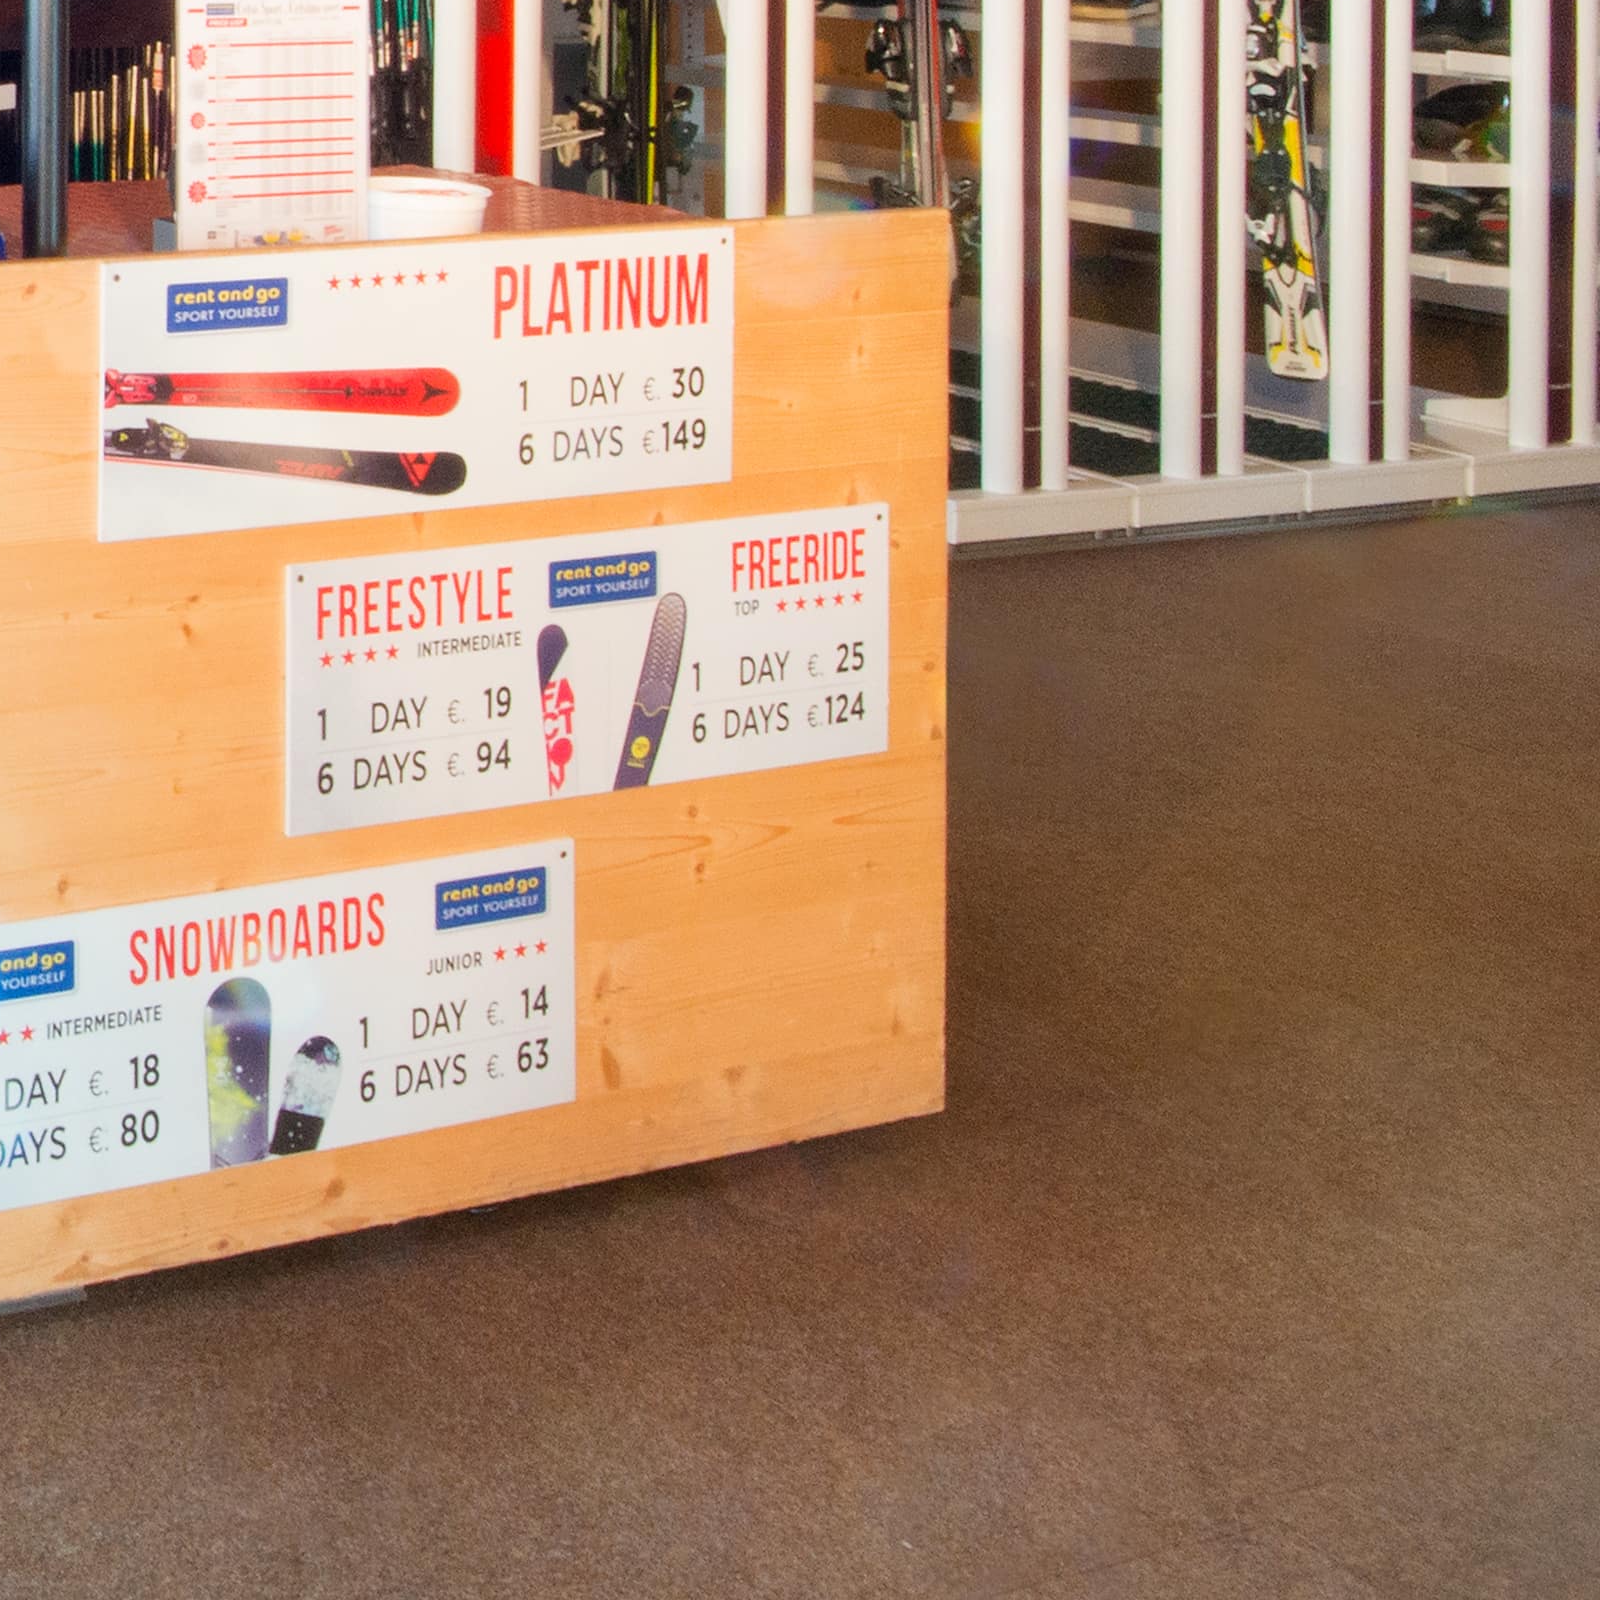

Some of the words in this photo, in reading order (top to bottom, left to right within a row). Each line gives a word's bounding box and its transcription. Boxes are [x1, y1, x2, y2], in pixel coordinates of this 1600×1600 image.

[174, 289, 216, 305] rent
[217, 284, 255, 303] and
[254, 287, 282, 305] go
[174, 309, 215, 324] SPORT
[217, 305, 280, 320] YOURSELF
[493, 252, 709, 340] PLATINUM
[519, 380, 528, 412] 1
[570, 372, 625, 408] DAY
[671, 365, 705, 400] 30
[518, 433, 535, 466] 6
[553, 425, 624, 462] DAYS
[555, 565, 592, 581] rent
[593, 560, 626, 578] and
[627, 560, 651, 578] go
[731, 527, 866, 595] FREERIDE
[316, 565, 514, 641] FREESTYLE
[556, 584, 591, 598] SPORT
[595, 578, 649, 593] YOURSELF
[735, 599, 759, 616] TOP
[418, 630, 521, 657] INTERMEDIATE
[692, 661, 701, 692] 1
[739, 650, 790, 687] DAY
[836, 640, 865, 674] 25
[317, 708, 327, 741] 1
[371, 695, 428, 734] DAY
[483, 685, 512, 720] 19
[692, 712, 707, 744] 6
[724, 701, 790, 740] DAYS
[317, 761, 335, 796] 6
[353, 749, 427, 791] DAYS
[476, 738, 512, 774] 94
[442, 885, 480, 903] rent
[481, 878, 516, 896] and
[516, 876, 540, 894] go
[443, 904, 478, 920] SPORT
[483, 895, 541, 918] YOURSELF
[129, 891, 385, 986] SNOWBOARDS
[0, 953, 39, 972] and
[40, 952, 66, 970] go
[0, 967, 65, 990] YOURSELF
[426, 951, 482, 976] JUNIOR
[47, 1004, 161, 1039] INTERMEDIATE
[359, 1016, 369, 1049] 1
[412, 999, 468, 1040] DAY
[520, 984, 549, 1019] 14
[5, 1068, 67, 1111] DAY
[129, 1053, 161, 1090] 18
[359, 1069, 377, 1103] 6
[395, 1053, 468, 1097] DAYS
[517, 1037, 549, 1074] 63
[120, 1109, 160, 1148] 80
